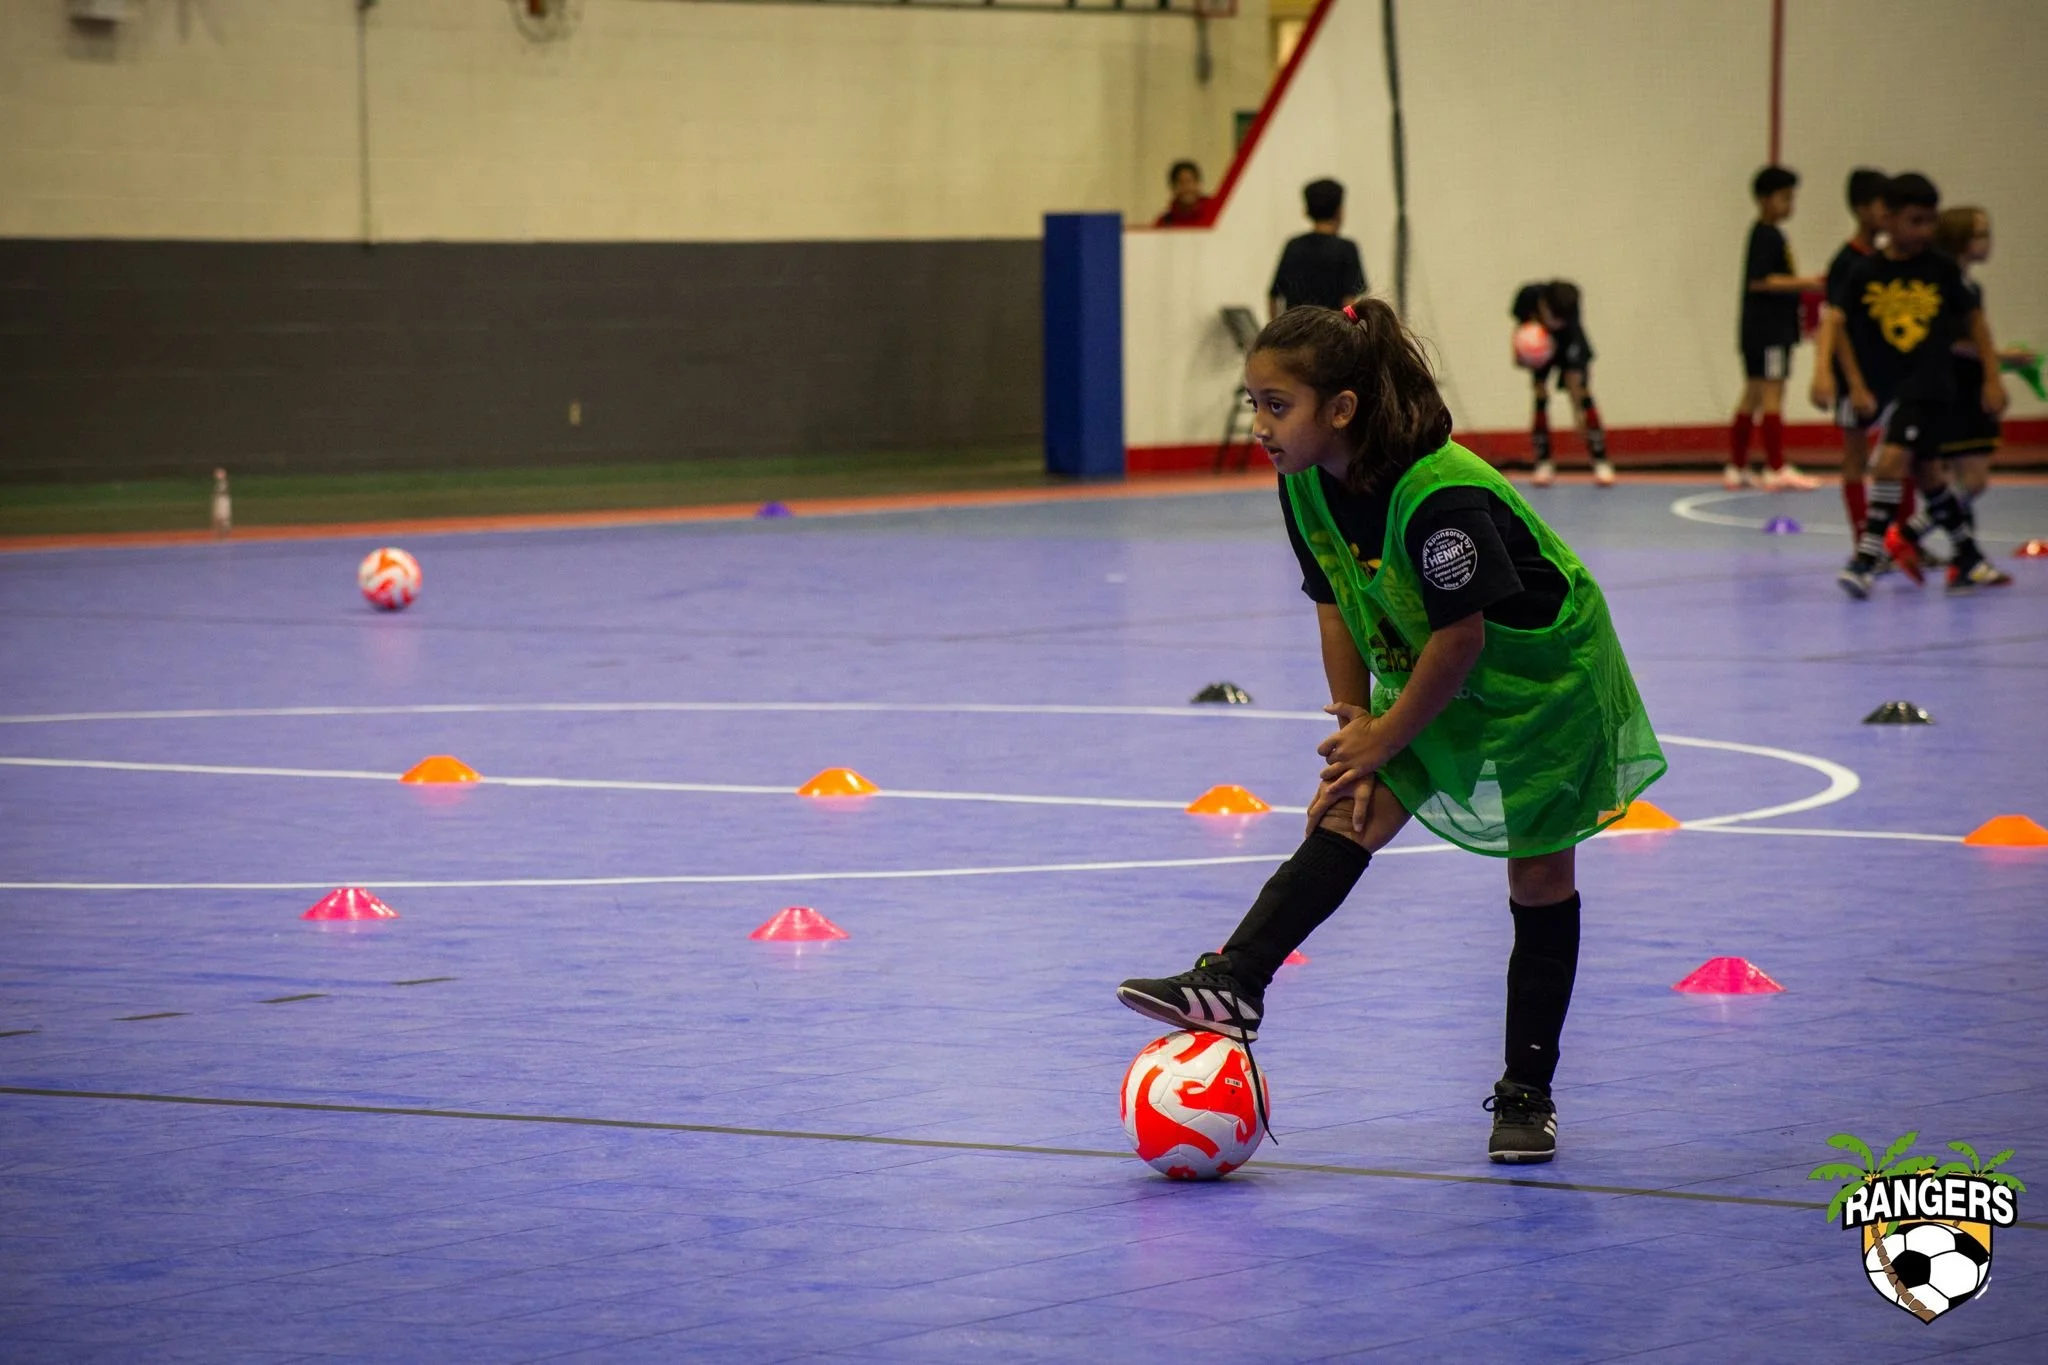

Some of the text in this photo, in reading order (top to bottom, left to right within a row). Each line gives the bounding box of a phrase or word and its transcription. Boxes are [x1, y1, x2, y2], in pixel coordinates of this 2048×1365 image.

[1428, 531, 1464, 547] sponsored
[1464, 538, 1472, 549] by
[1428, 541, 1464, 568] HENRY
